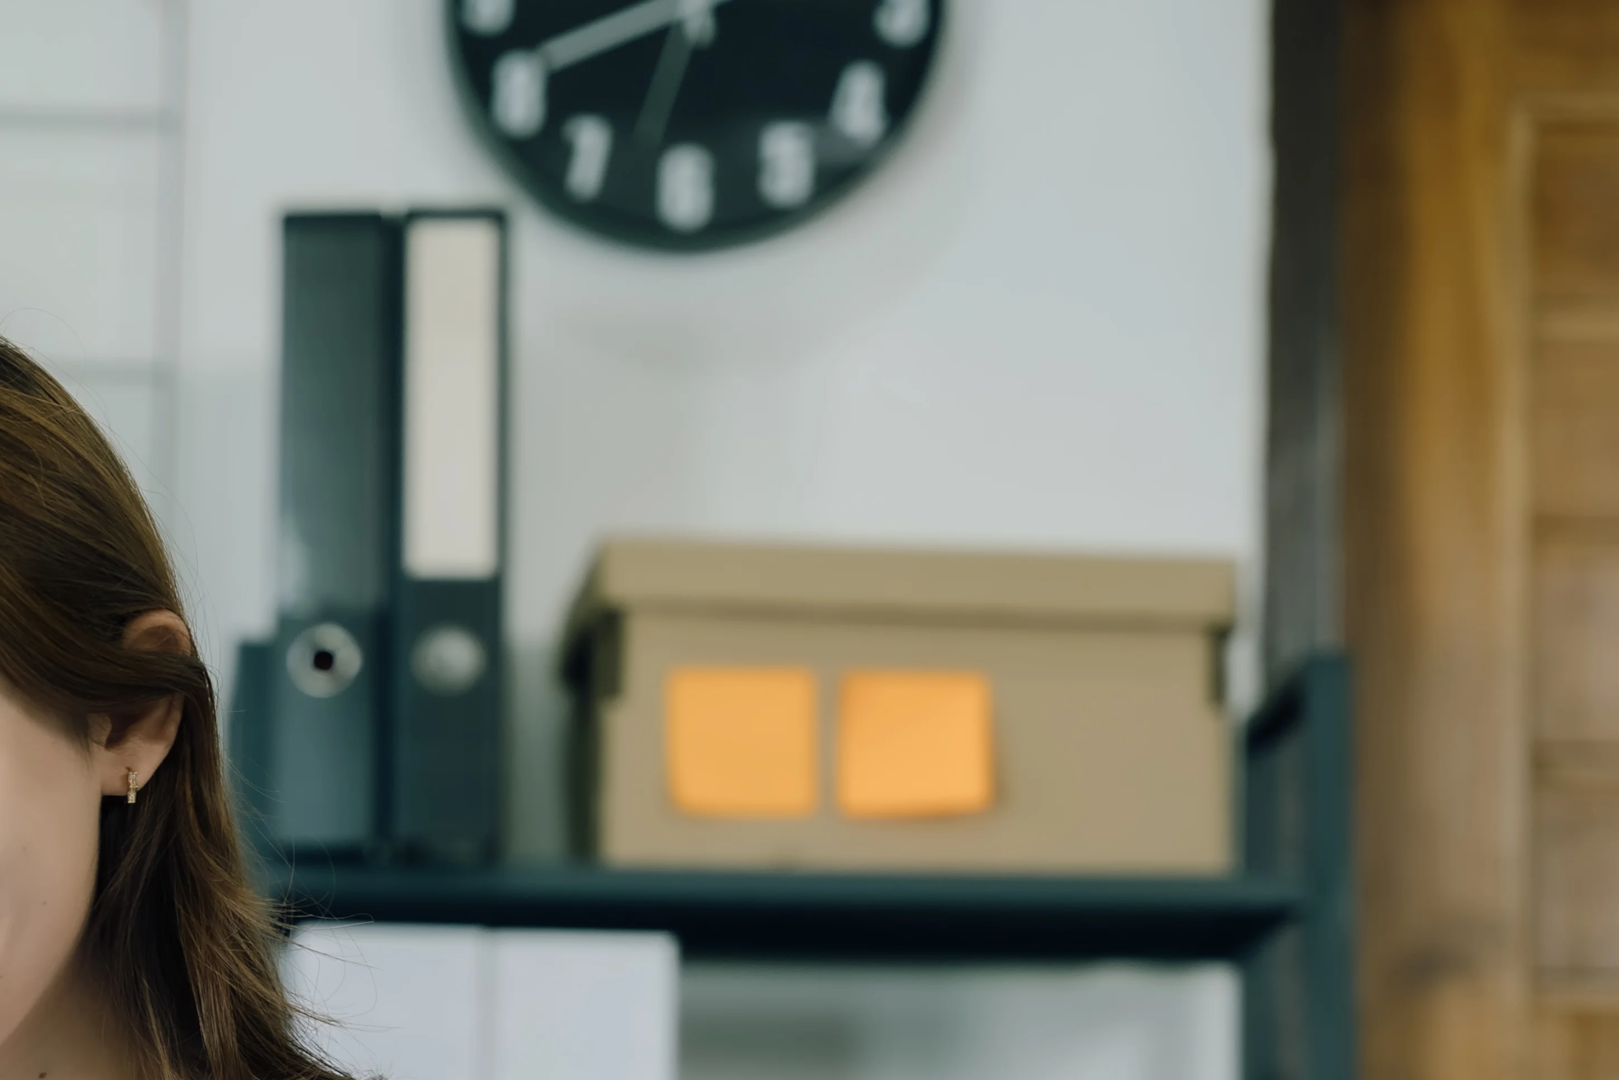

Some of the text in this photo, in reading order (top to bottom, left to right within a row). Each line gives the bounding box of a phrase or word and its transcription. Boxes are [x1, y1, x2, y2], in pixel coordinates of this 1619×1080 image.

[829, 62, 886, 149] 4
[564, 115, 611, 199] 7
[656, 143, 714, 231] 6
[758, 121, 816, 206] 5
